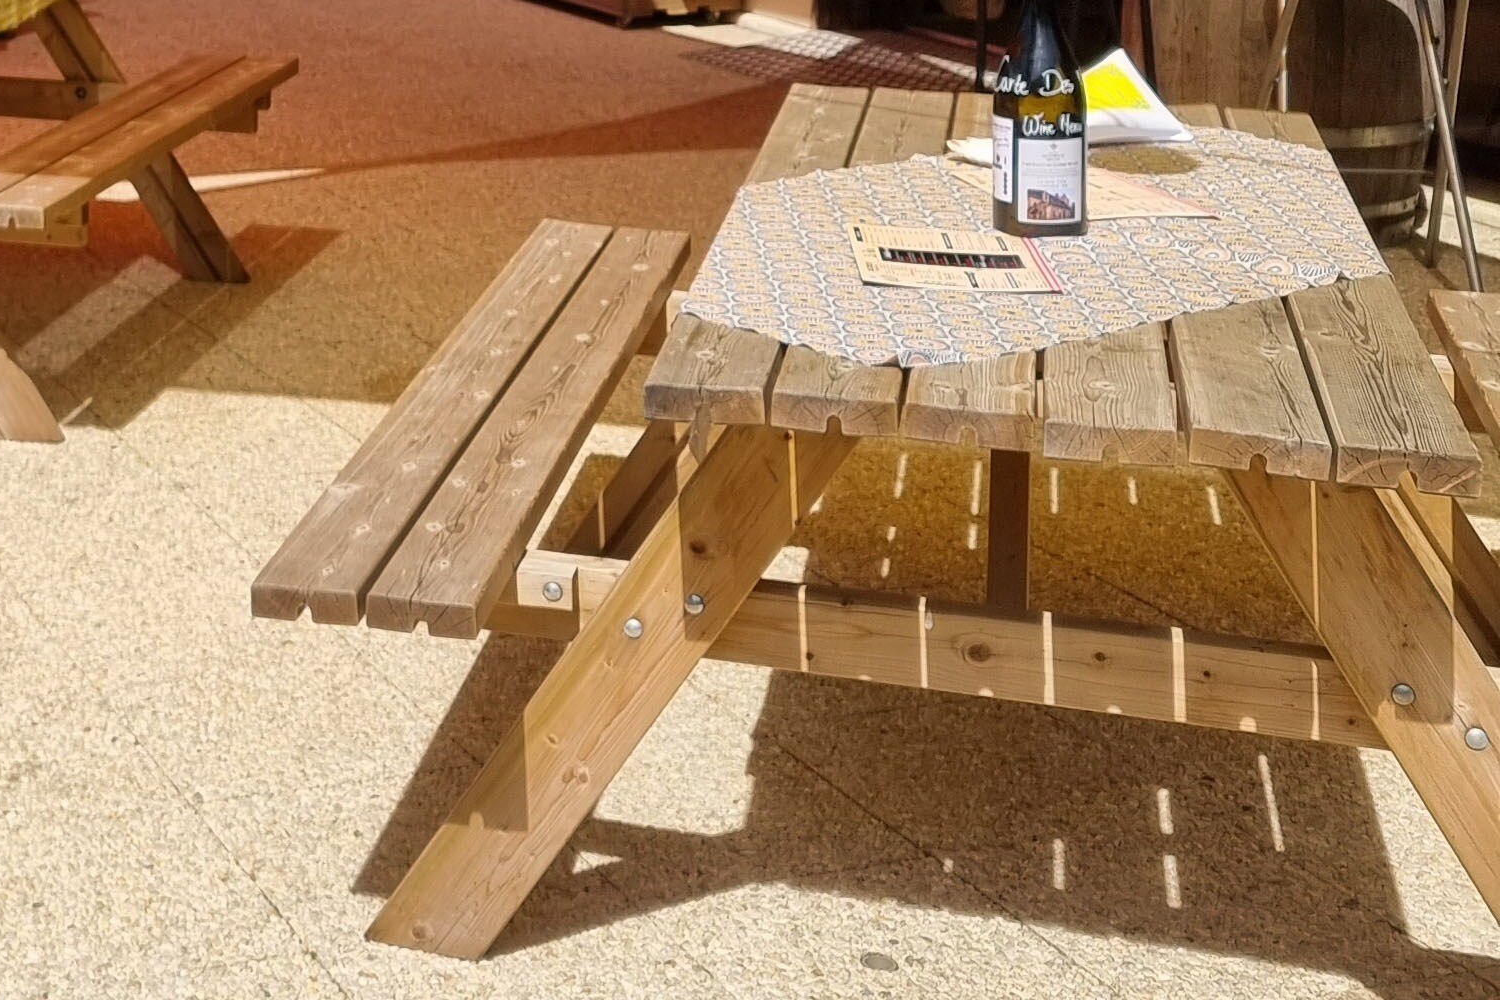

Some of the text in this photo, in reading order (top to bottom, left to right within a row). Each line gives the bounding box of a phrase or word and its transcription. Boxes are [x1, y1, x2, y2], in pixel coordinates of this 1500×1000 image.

[994, 54, 1075, 97] Carte Des
[1022, 112, 1056, 137] Wine
